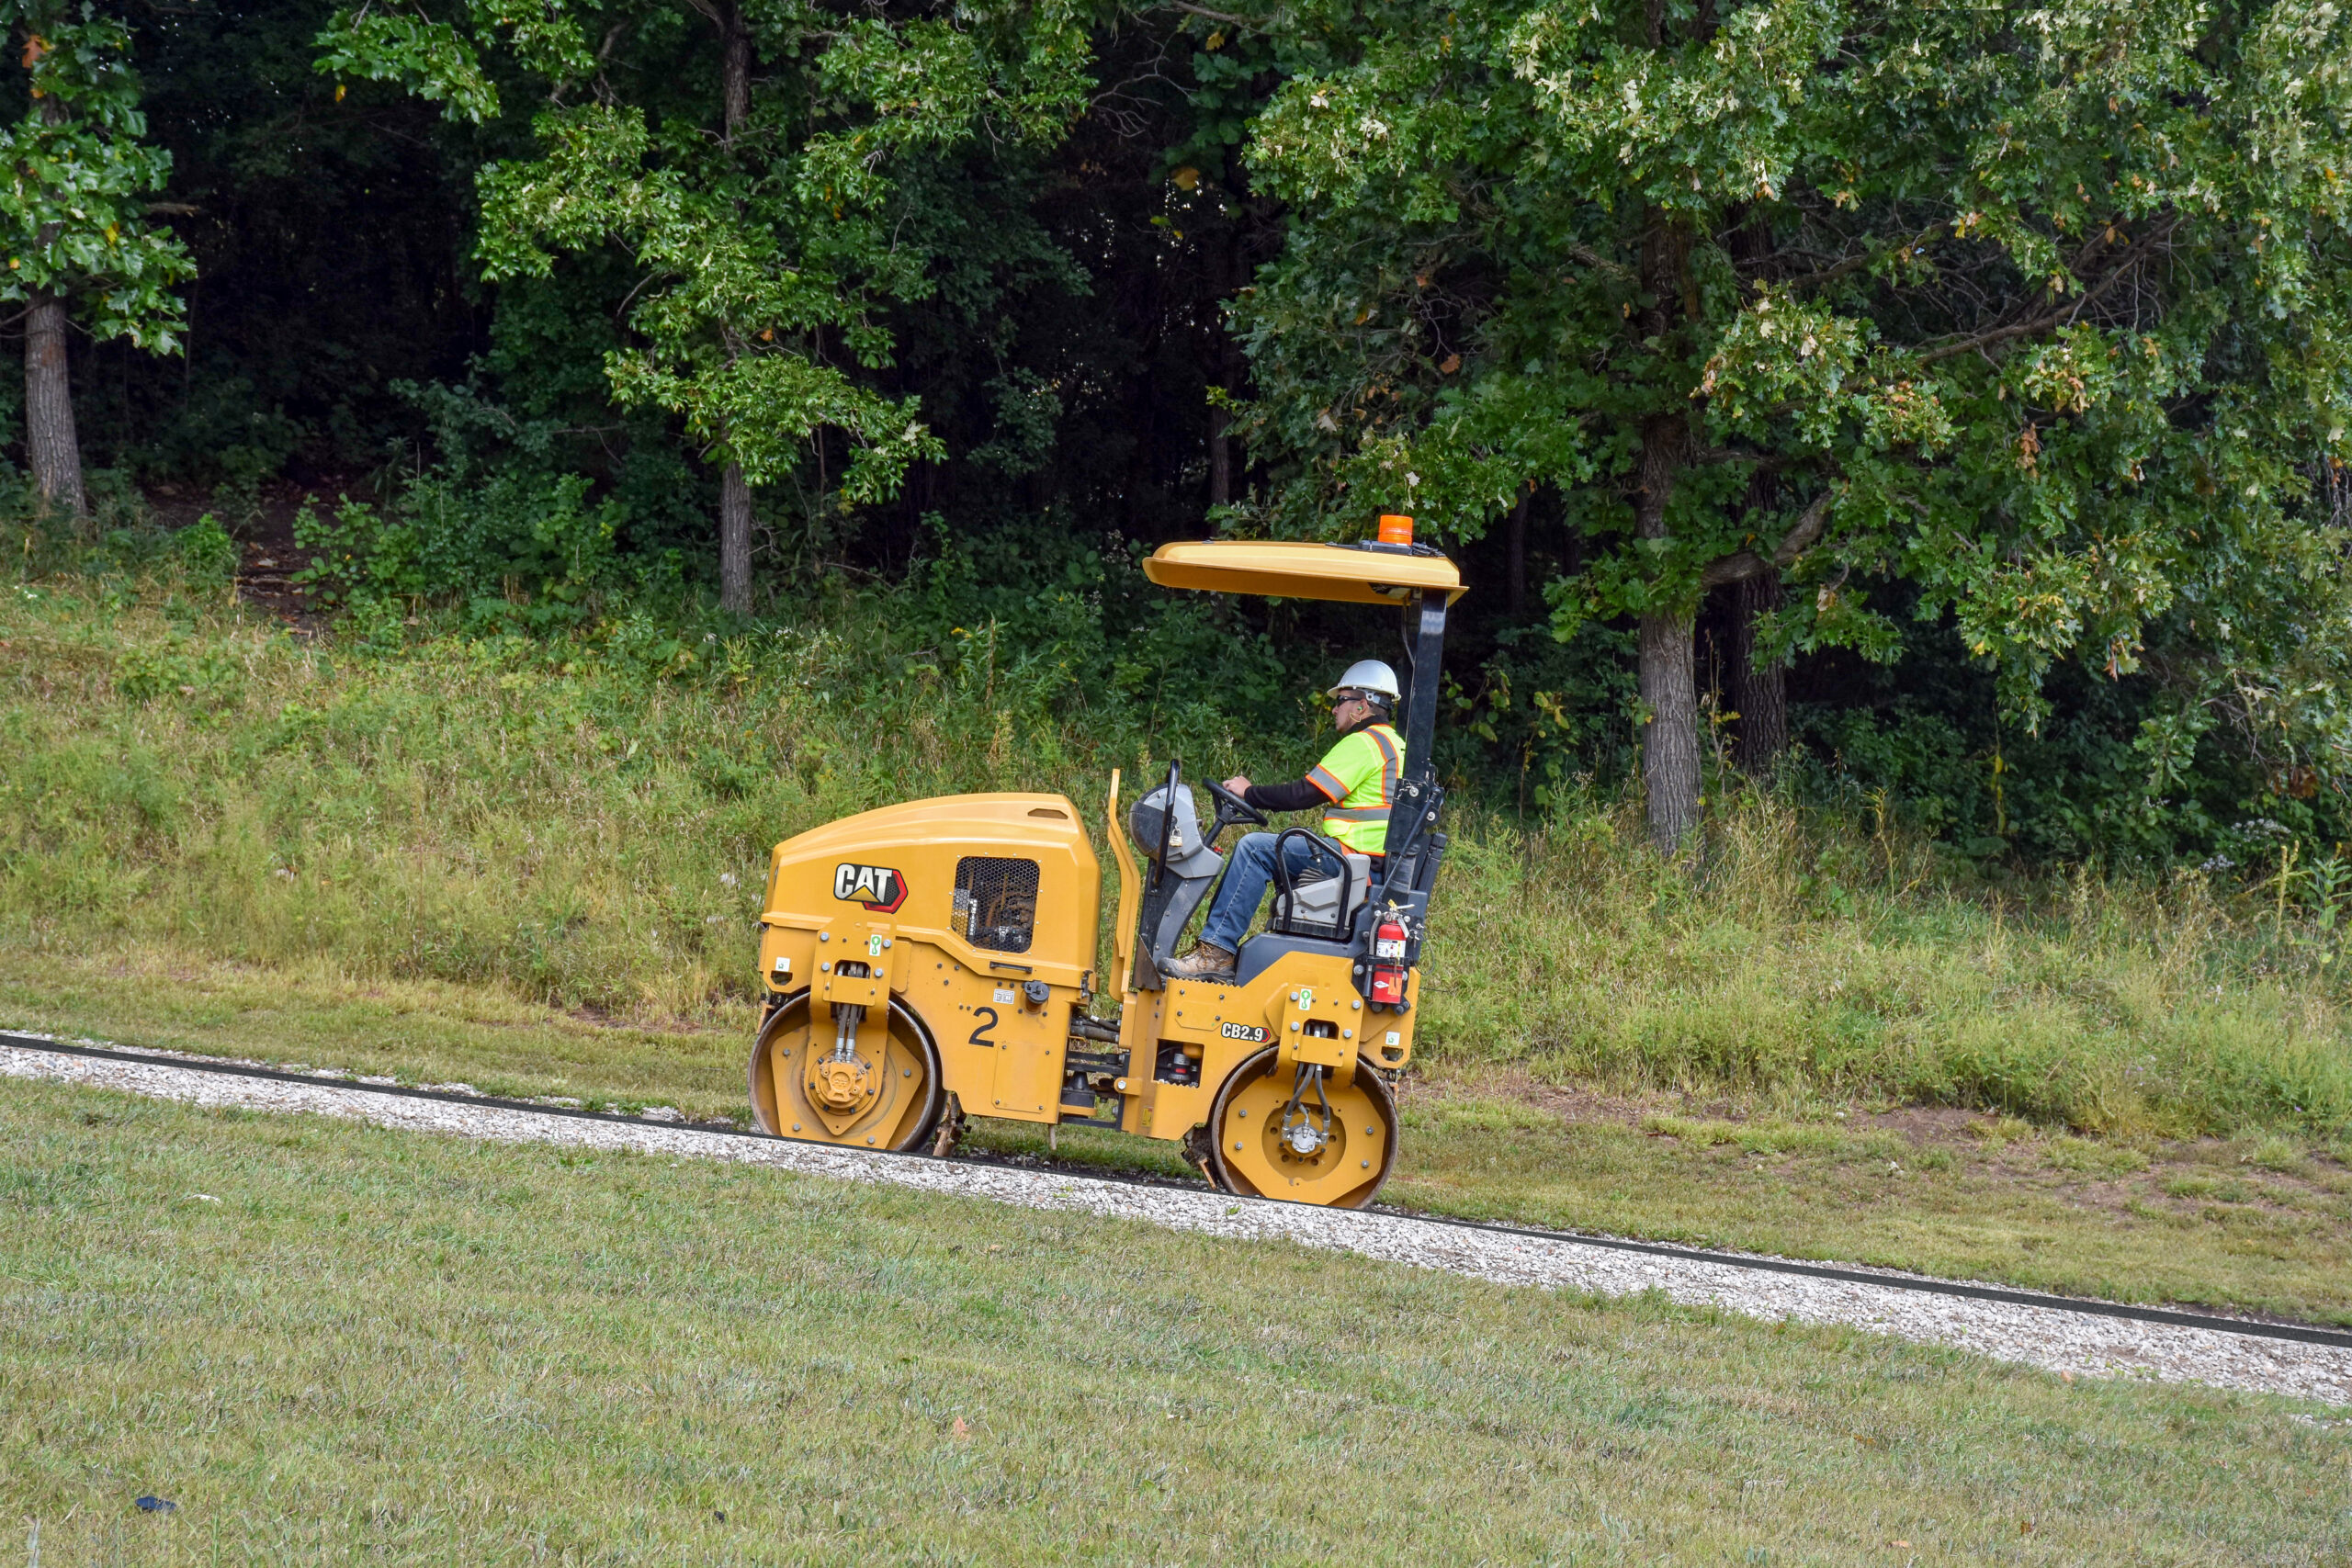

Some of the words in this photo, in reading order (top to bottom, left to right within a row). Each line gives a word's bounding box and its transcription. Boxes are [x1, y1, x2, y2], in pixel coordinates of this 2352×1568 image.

[834, 863, 893, 903] CAT
[968, 1006, 999, 1048] 2
[1222, 1022, 1263, 1042] CB2.9
